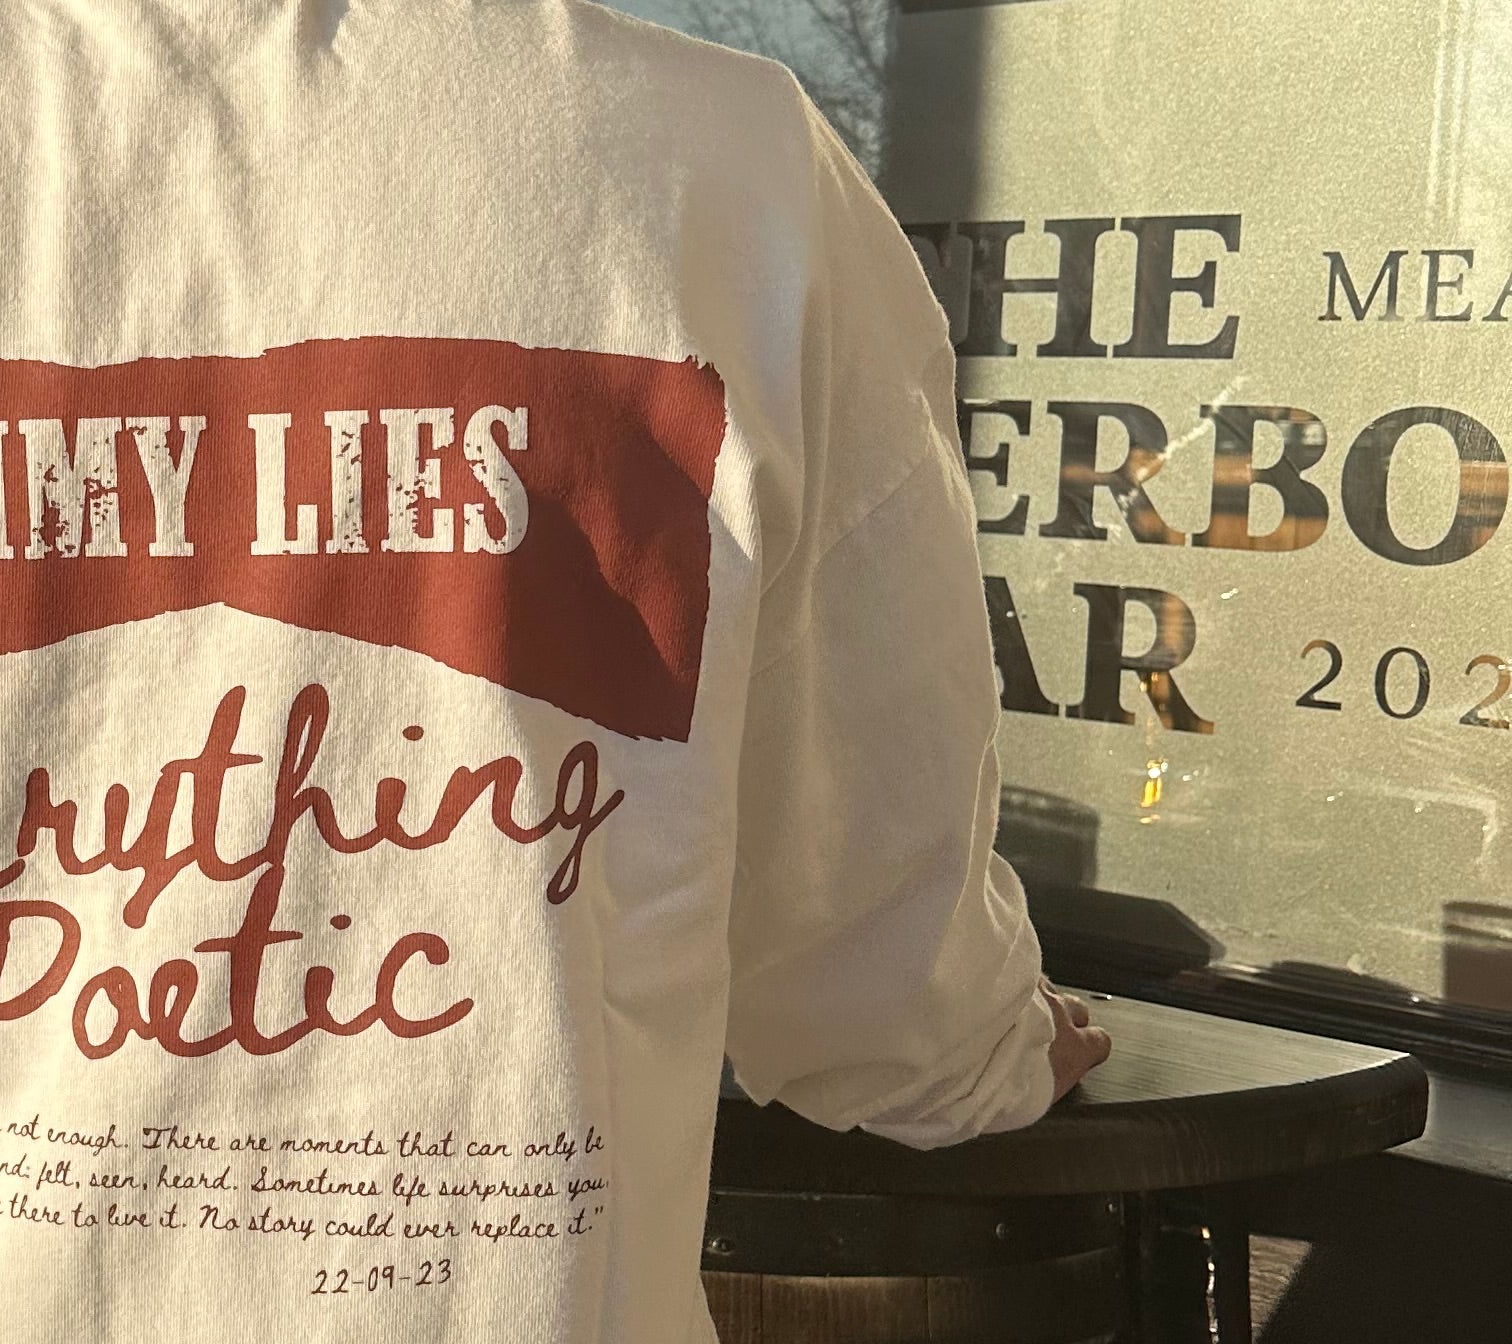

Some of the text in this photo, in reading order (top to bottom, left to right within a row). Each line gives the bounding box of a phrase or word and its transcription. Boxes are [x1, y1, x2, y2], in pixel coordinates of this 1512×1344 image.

[248, 404, 530, 557] LIES
[8, 1113, 40, 1140] not
[47, 1124, 129, 1156] enough.
[143, 1125, 220, 1150] There
[230, 1134, 271, 1151] are
[280, 1130, 389, 1156] moments
[397, 1130, 455, 1157] that
[466, 1141, 512, 1157] can
[524, 1132, 577, 1161] only
[585, 1126, 605, 1154] be
[36, 1160, 81, 1190] felt,
[89, 1172, 148, 1190] seen,
[157, 1164, 238, 1190] heard.
[251, 1166, 381, 1197] Sometimes
[392, 1172, 431, 1206] life
[439, 1180, 558, 1201] surprises
[10, 1193, 65, 1225] there
[72, 1202, 98, 1227] to
[108, 1203, 152, 1228] live
[159, 1203, 187, 1229] it.
[199, 1204, 240, 1231] No
[248, 1207, 316, 1241] story
[325, 1212, 394, 1238] could
[404, 1220, 460, 1238] ever
[471, 1213, 559, 1243] replace
[311, 1258, 452, 1294] 22-09-23
